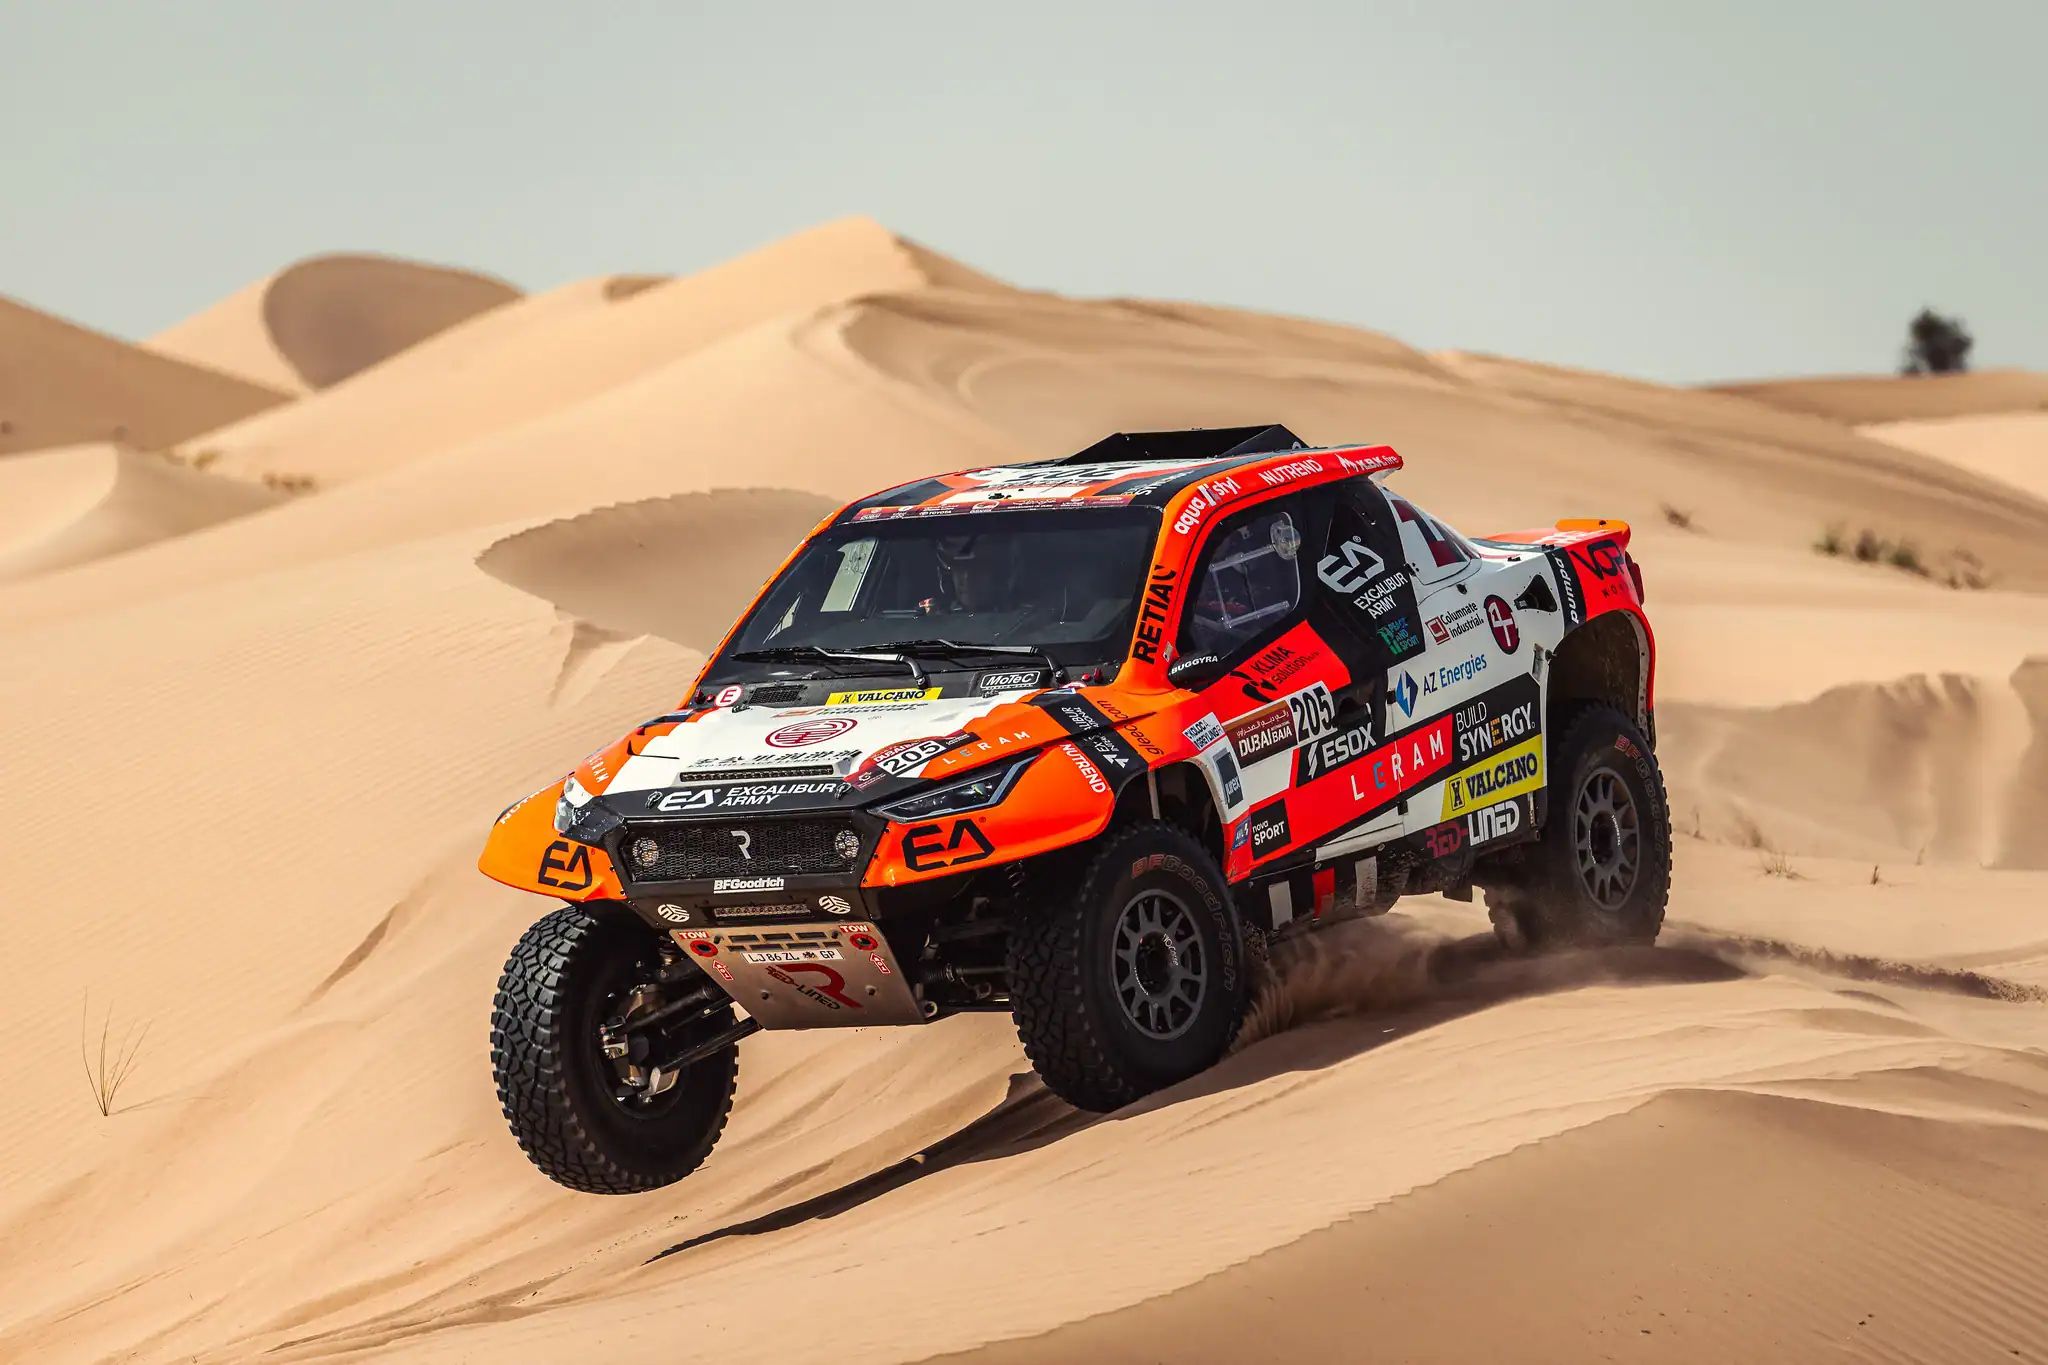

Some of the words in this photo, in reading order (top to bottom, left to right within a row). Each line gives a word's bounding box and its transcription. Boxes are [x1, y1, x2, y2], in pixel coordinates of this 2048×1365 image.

[1257, 459, 1323, 486] NUTREND
[1353, 571, 1408, 611] EXCALIBUR
[1555, 556, 1579, 625] pumpa
[1367, 594, 1397, 620] ARMY
[1440, 601, 1478, 626] Columnate
[1171, 655, 1218, 675] BUGGYRA
[1251, 645, 1296, 676] KLIMA
[988, 673, 1035, 686] MoTeC
[1423, 671, 1438, 697] AZ
[1439, 653, 1488, 689] Energies
[857, 690, 926, 702] VALCANO
[1288, 685, 1336, 744] 205
[1455, 701, 1488, 732] BUILD
[873, 746, 904, 762] DUBAI
[1239, 728, 1272, 758] DUBAI
[1272, 725, 1293, 744] BAJA
[1322, 722, 1377, 769] ESOX
[882, 741, 941, 772] 205
[1059, 744, 1106, 793] NUTREND
[1465, 751, 1538, 799] VALCANO
[718, 794, 780, 808] ARMY
[726, 782, 837, 797] EXCALIBUR
[1252, 819, 1269, 833] nova
[1254, 821, 1285, 846] SPORT
[713, 876, 785, 891] BFGoodrich
[680, 930, 707, 940] TOW
[841, 924, 868, 933] TOW
[819, 950, 836, 959] GP
